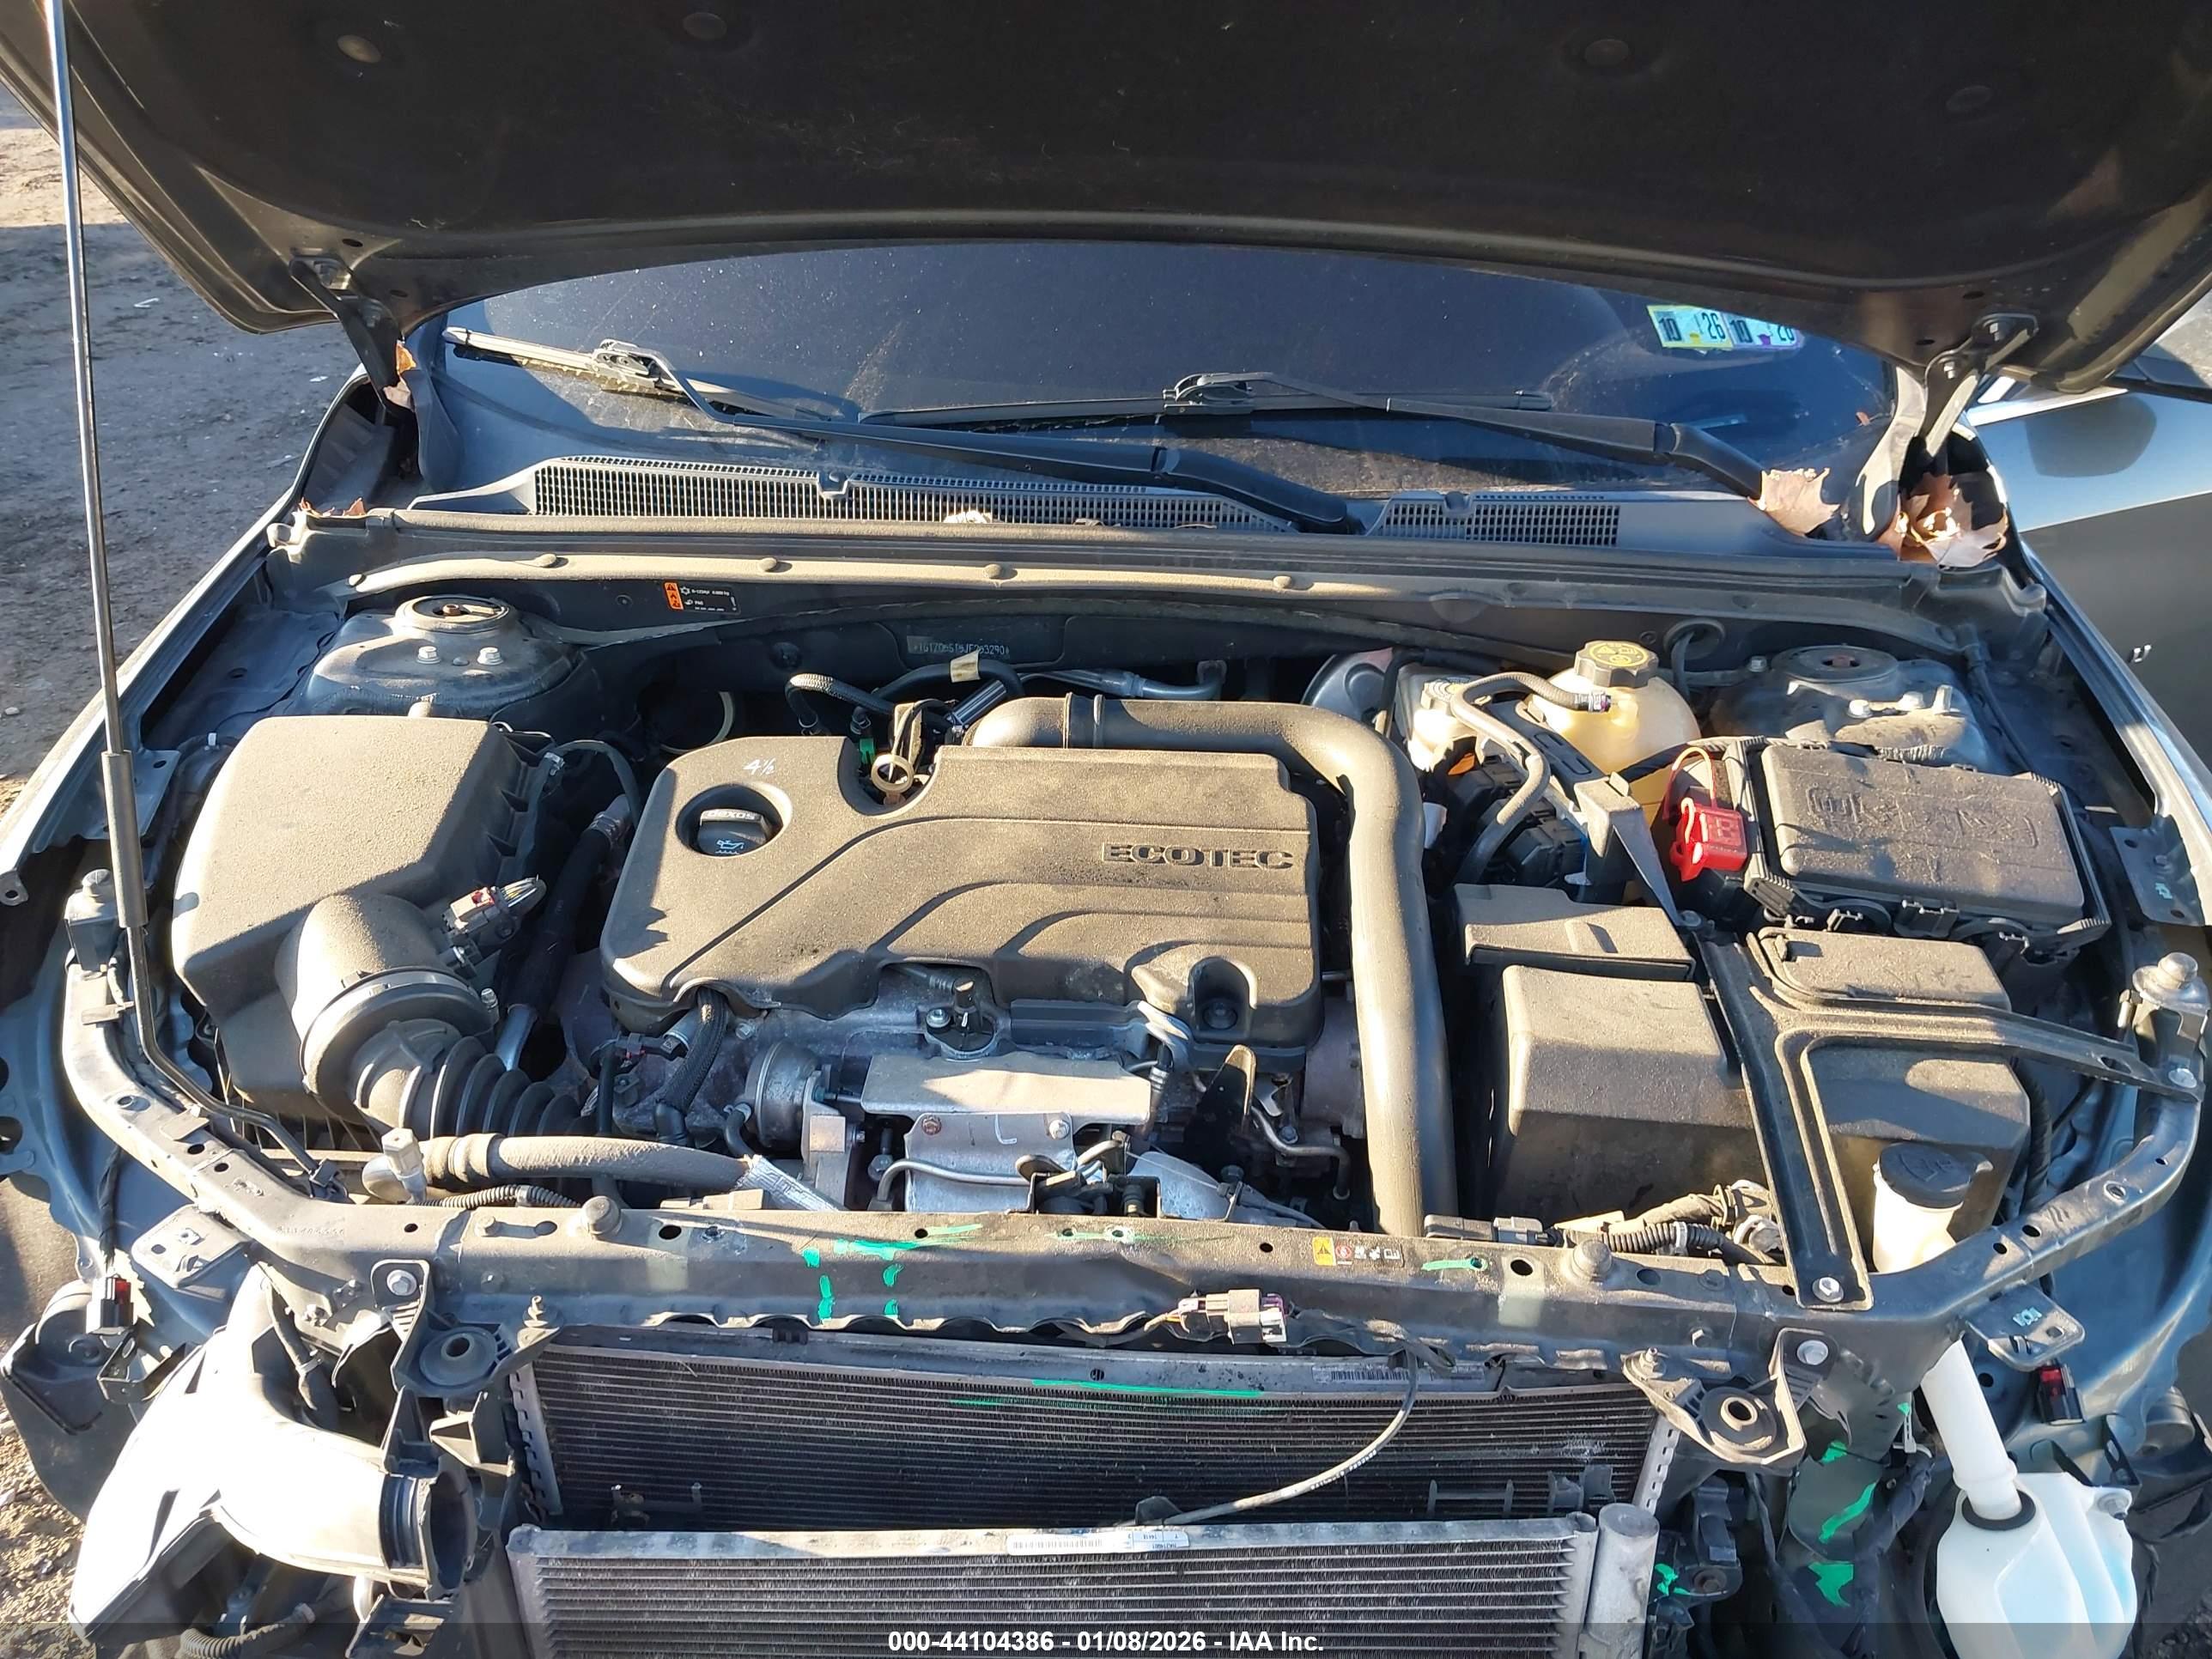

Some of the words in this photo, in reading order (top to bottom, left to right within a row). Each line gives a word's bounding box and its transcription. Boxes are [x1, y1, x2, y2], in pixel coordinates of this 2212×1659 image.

[1658, 317, 1682, 342] 10
[1702, 312, 1726, 340] 26
[1729, 319, 1753, 343] 10
[1101, 842, 1293, 870] ECOTEC
